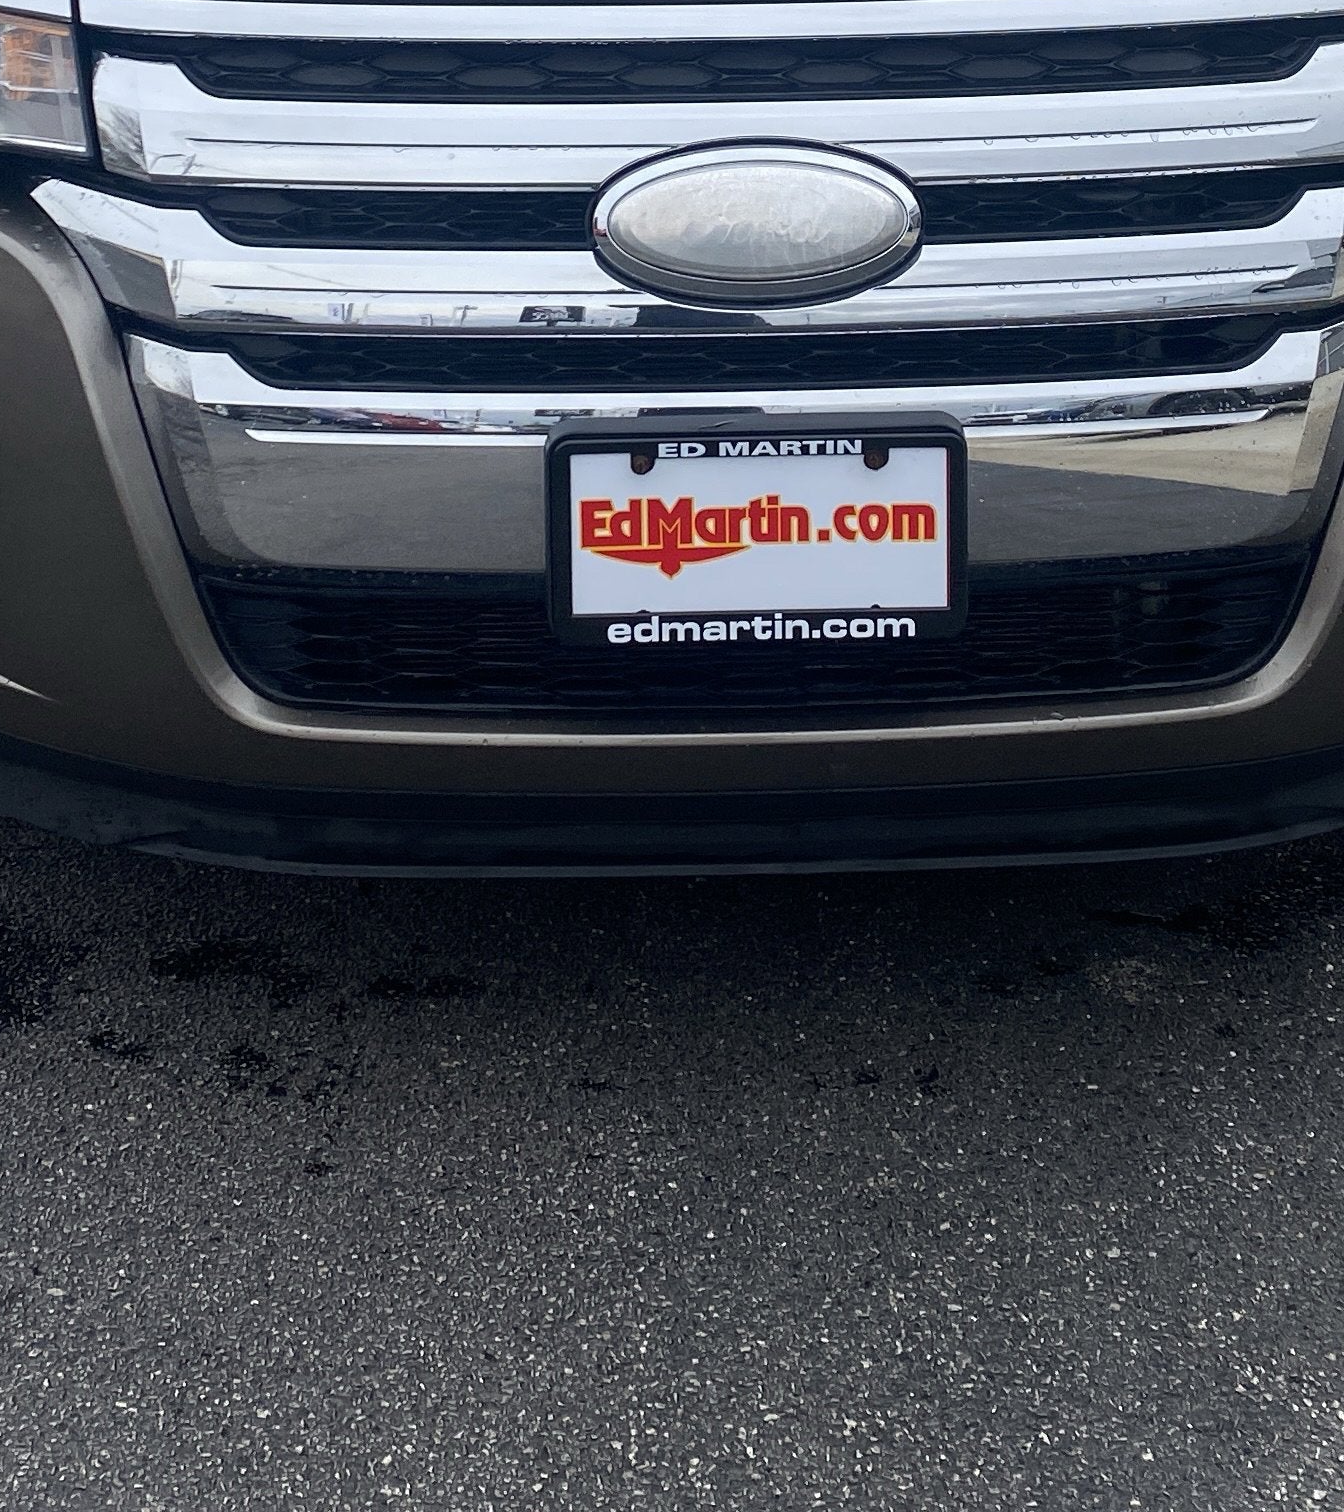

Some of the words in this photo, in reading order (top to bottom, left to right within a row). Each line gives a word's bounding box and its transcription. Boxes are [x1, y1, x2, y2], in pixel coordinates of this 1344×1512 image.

[657, 442, 707, 459] ED
[718, 439, 863, 457] MARTIN
[580, 494, 937, 550] EdMartin.com
[607, 612, 917, 644] edmartin.com
